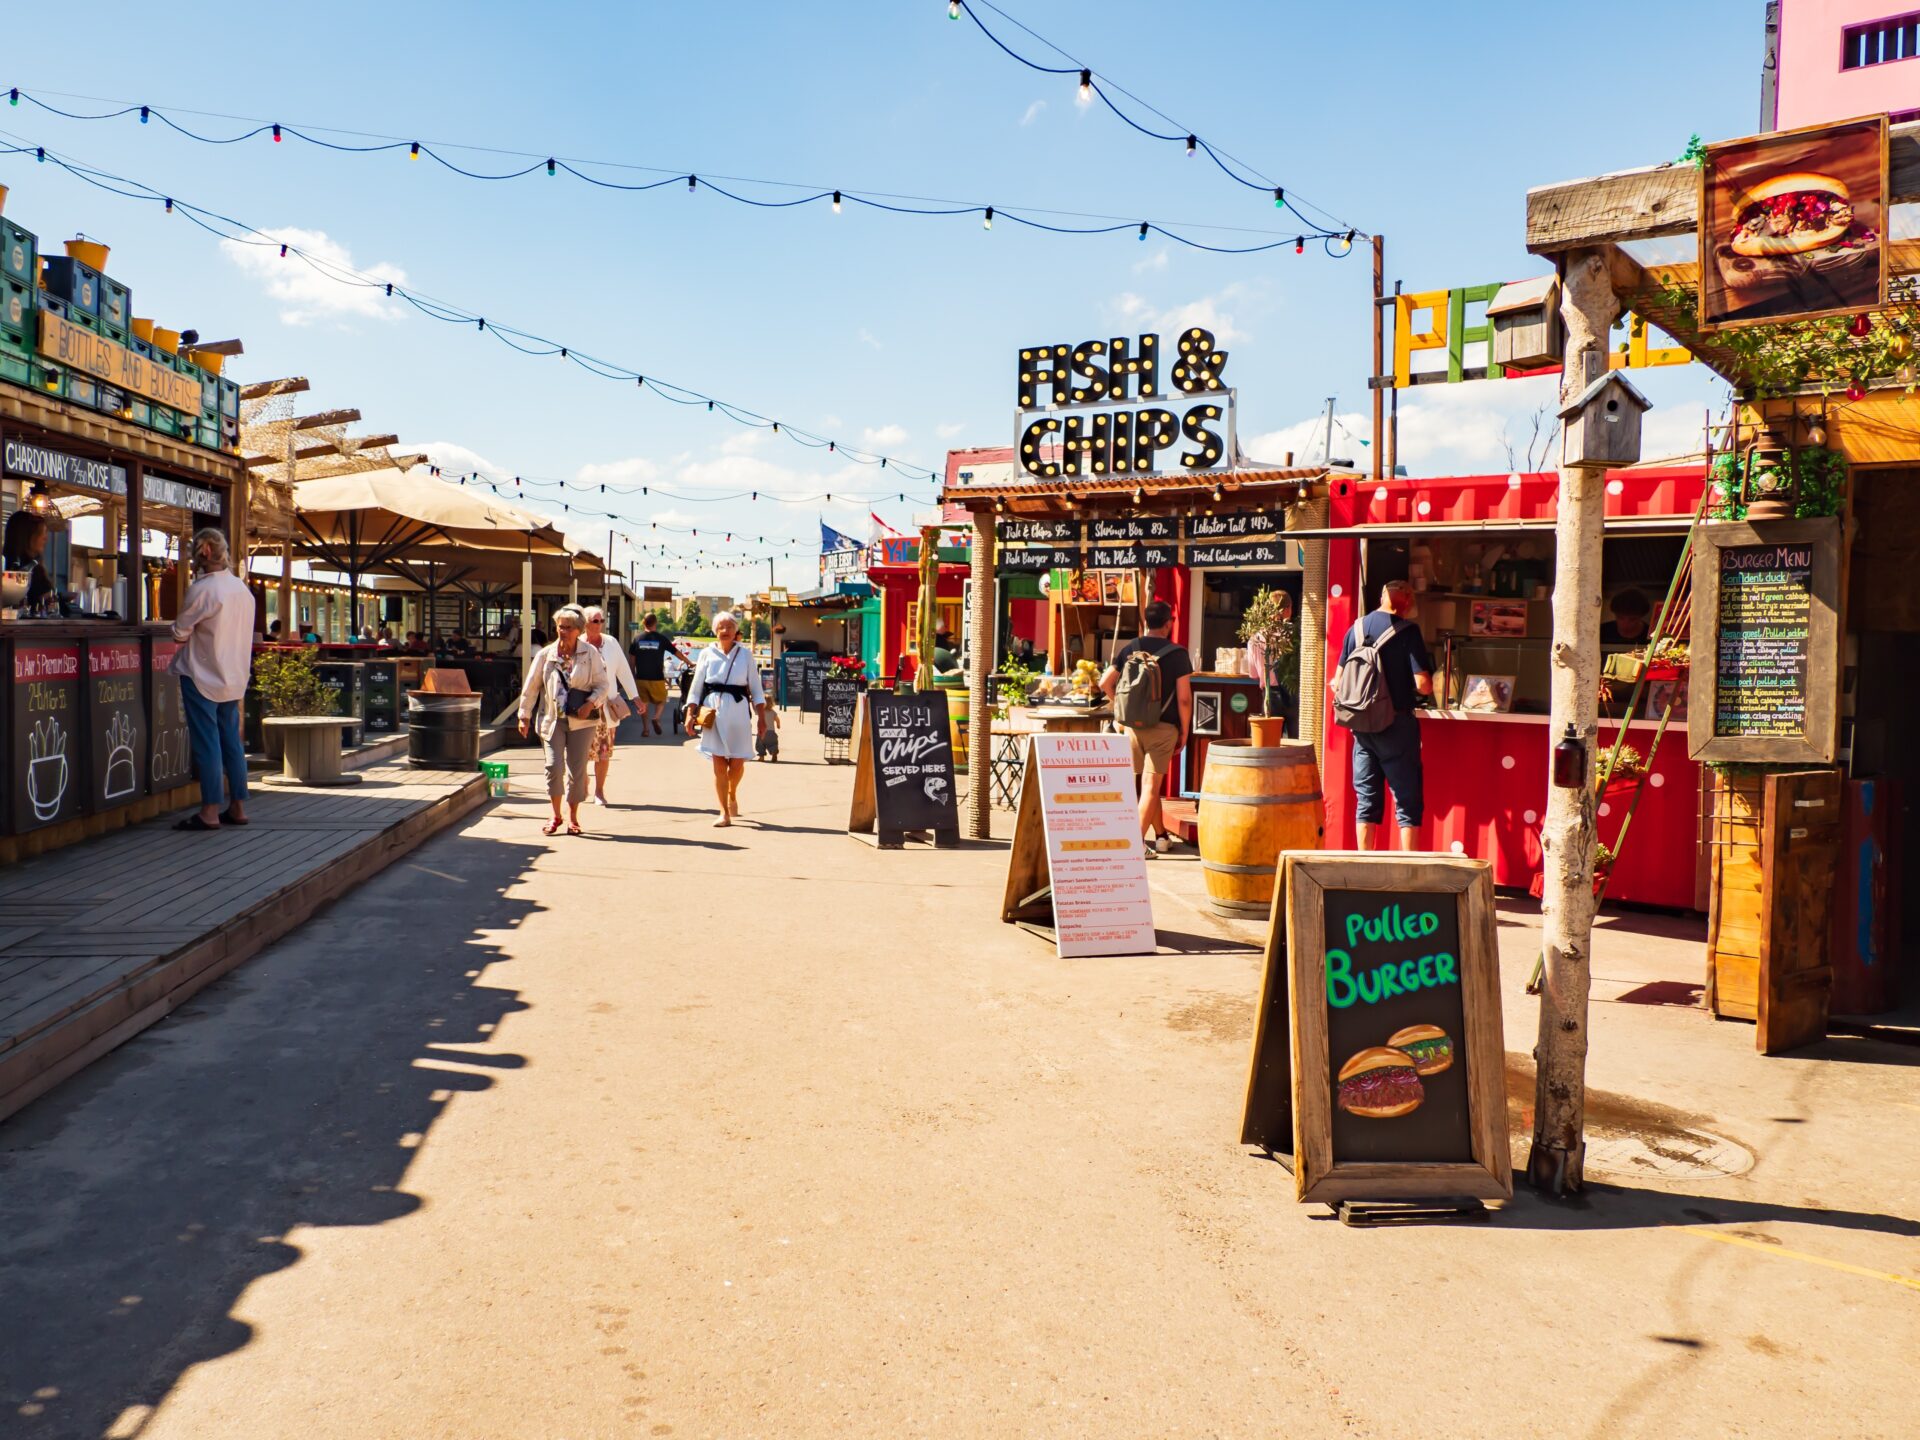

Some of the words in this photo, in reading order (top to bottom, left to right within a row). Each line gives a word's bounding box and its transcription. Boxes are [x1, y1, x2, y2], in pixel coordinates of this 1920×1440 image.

[59, 321, 112, 378] BOTTLES
[121, 351, 142, 389] AND
[1018, 333, 1159, 407] FISH
[1171, 327, 1229, 393] &
[1020, 404, 1224, 477] CHIPS
[5, 442, 69, 481] CHARDONNAY
[87, 462, 109, 490] ROSE
[1006, 524, 1020, 538] Fish
[1023, 524, 1028, 539] &
[1031, 522, 1052, 539] Chips
[1095, 521, 1126, 538] Shrimp
[1128, 522, 1143, 536] Box
[1194, 517, 1226, 534] Lobster
[1228, 517, 1246, 533] Tail
[1005, 550, 1020, 564] Fish
[1022, 552, 1048, 567] Burger
[1094, 550, 1111, 566] Mix
[1113, 548, 1136, 565] Plate
[1194, 548, 1213, 563] Fried
[1215, 549, 1252, 562] Calamari
[1722, 550, 1773, 569] BURGER
[1775, 547, 1811, 568] MENU
[1722, 572, 1763, 583] Confident
[1732, 593, 1748, 601] fresh
[1749, 593, 1760, 601] red
[1765, 594, 1784, 602] green
[37, 654, 41, 674] 5
[110, 650, 115, 670] 5
[1780, 675, 1796, 687] pork
[1743, 696, 1759, 704] fresh
[877, 705, 930, 727] FISH
[1752, 713, 1770, 721] crispy
[1773, 720, 1794, 729] topped
[1745, 727, 1759, 736] pink
[880, 730, 938, 764] Chips
[882, 765, 919, 775] SERVED
[922, 764, 946, 773] HERE
[1325, 948, 1458, 1008] BURGER
